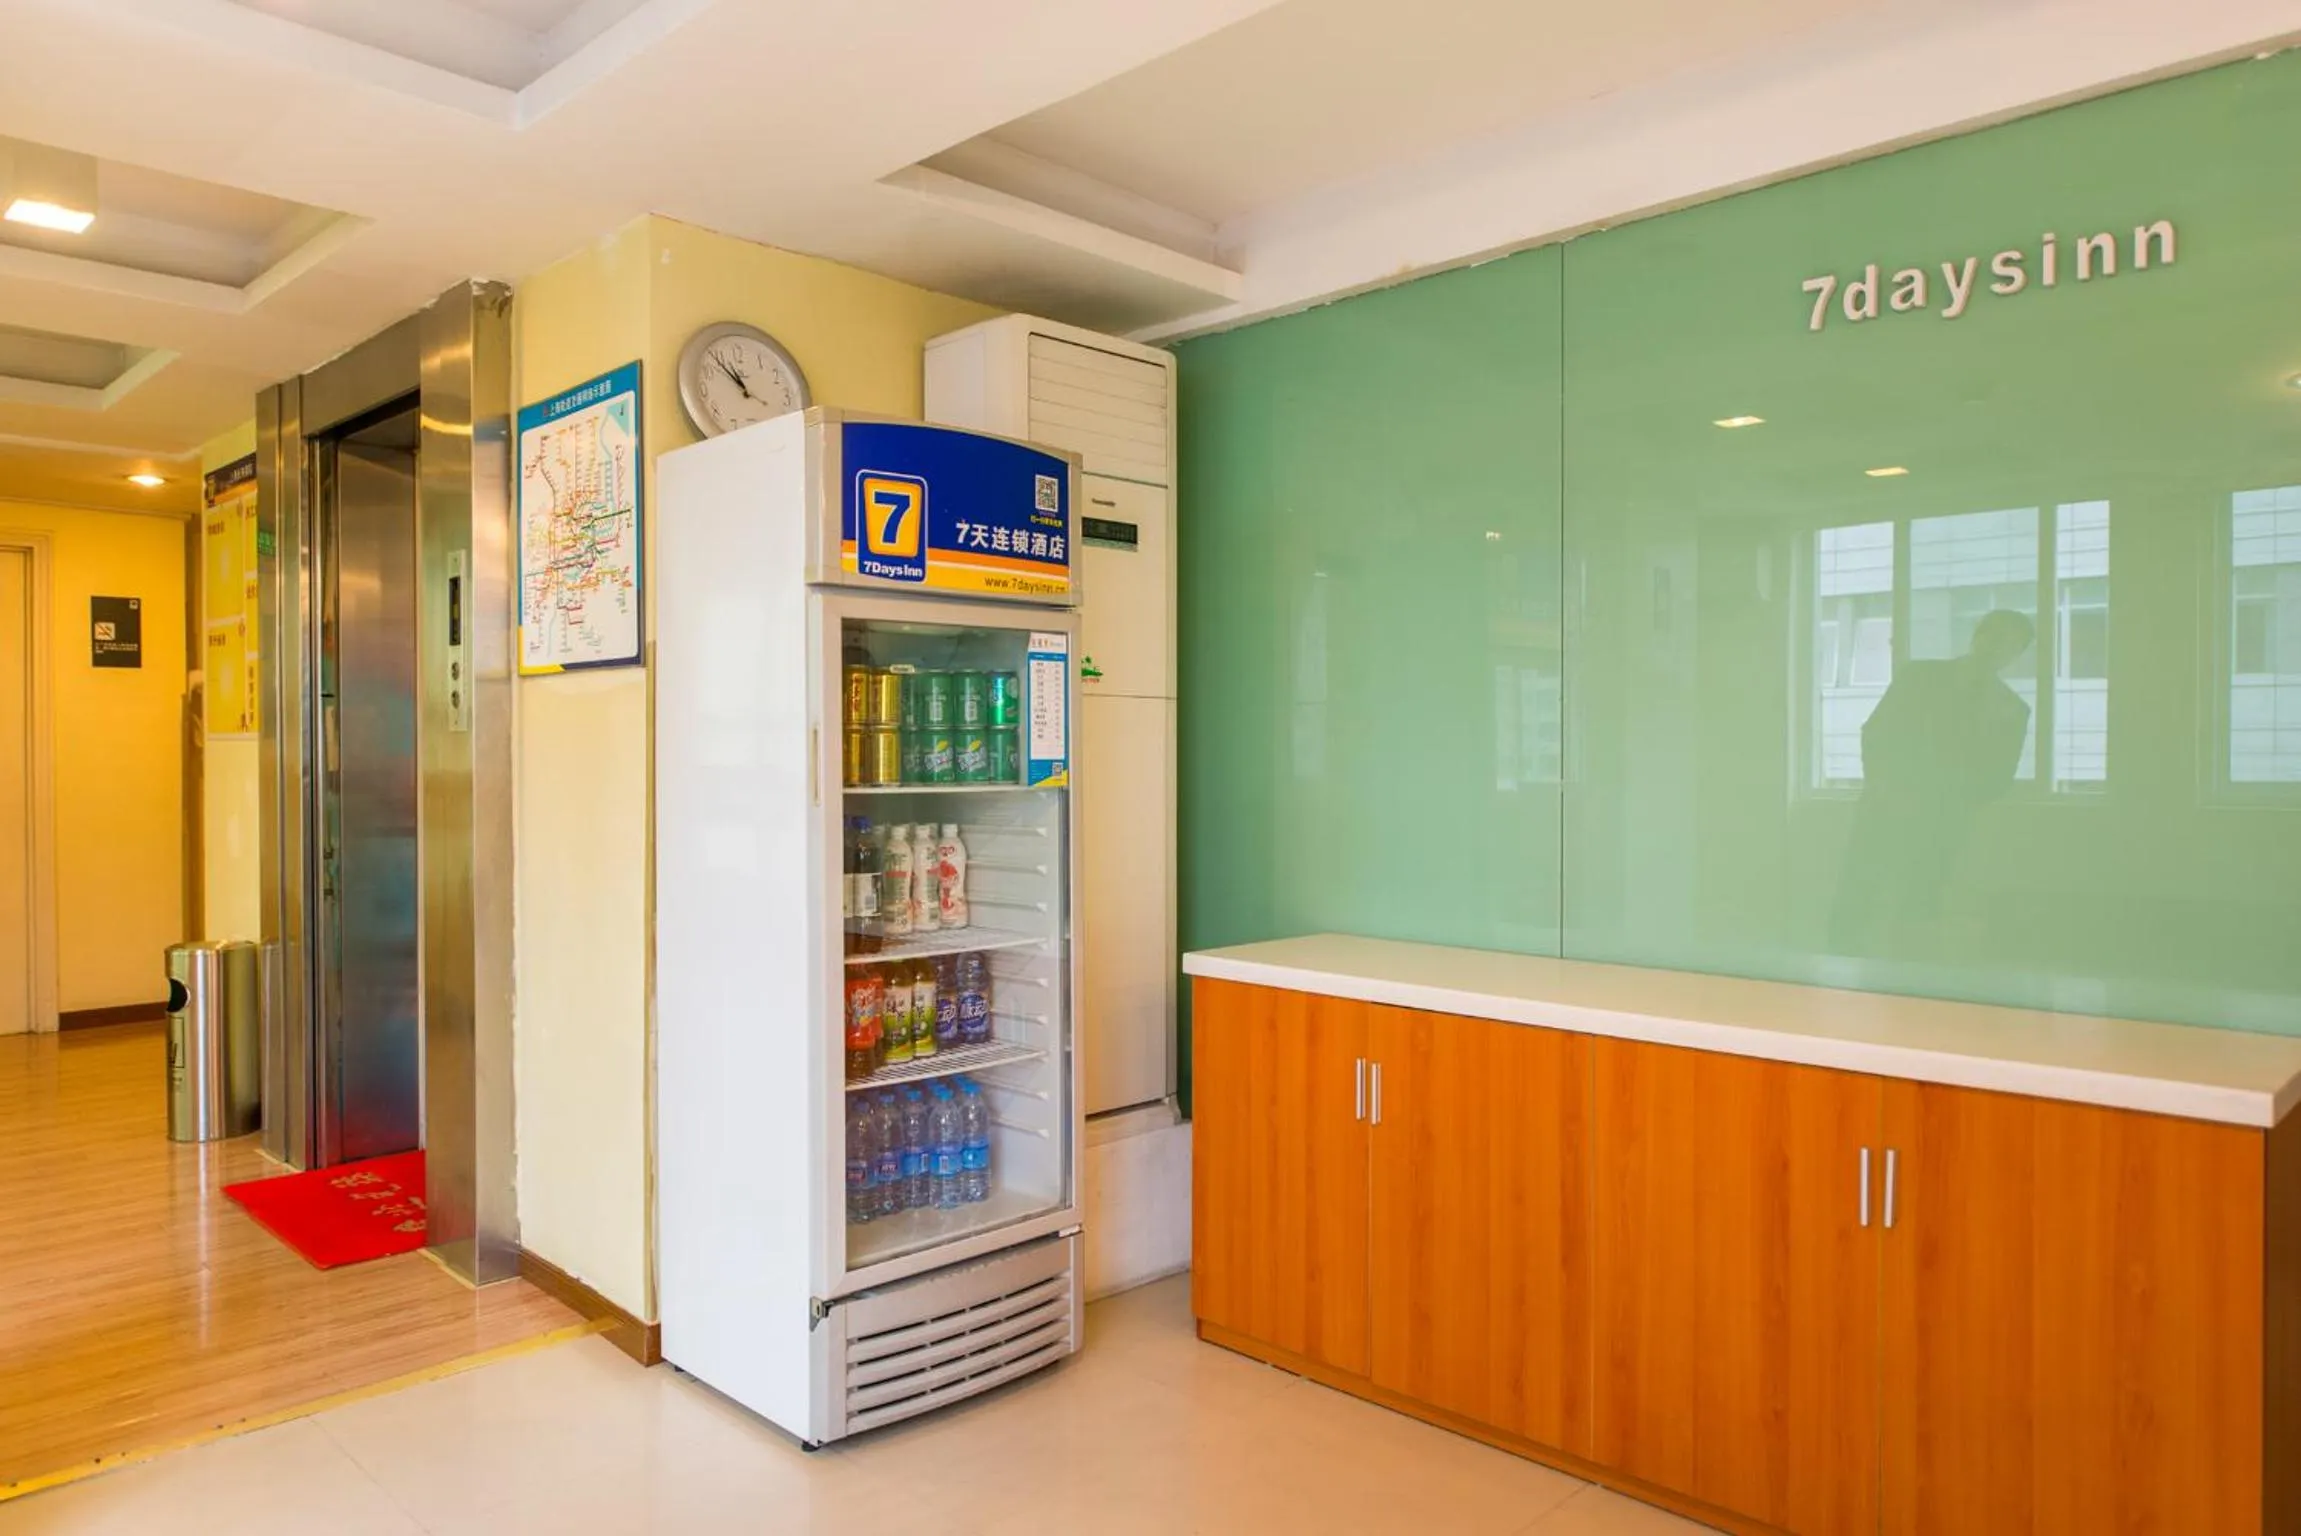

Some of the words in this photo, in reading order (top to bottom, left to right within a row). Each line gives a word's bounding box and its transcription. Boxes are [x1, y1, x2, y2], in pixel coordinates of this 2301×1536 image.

[1801, 218, 2177, 331] 7daysinn
[873, 489, 913, 545] 7
[956, 522, 1066, 559] 7天连锁酒店
